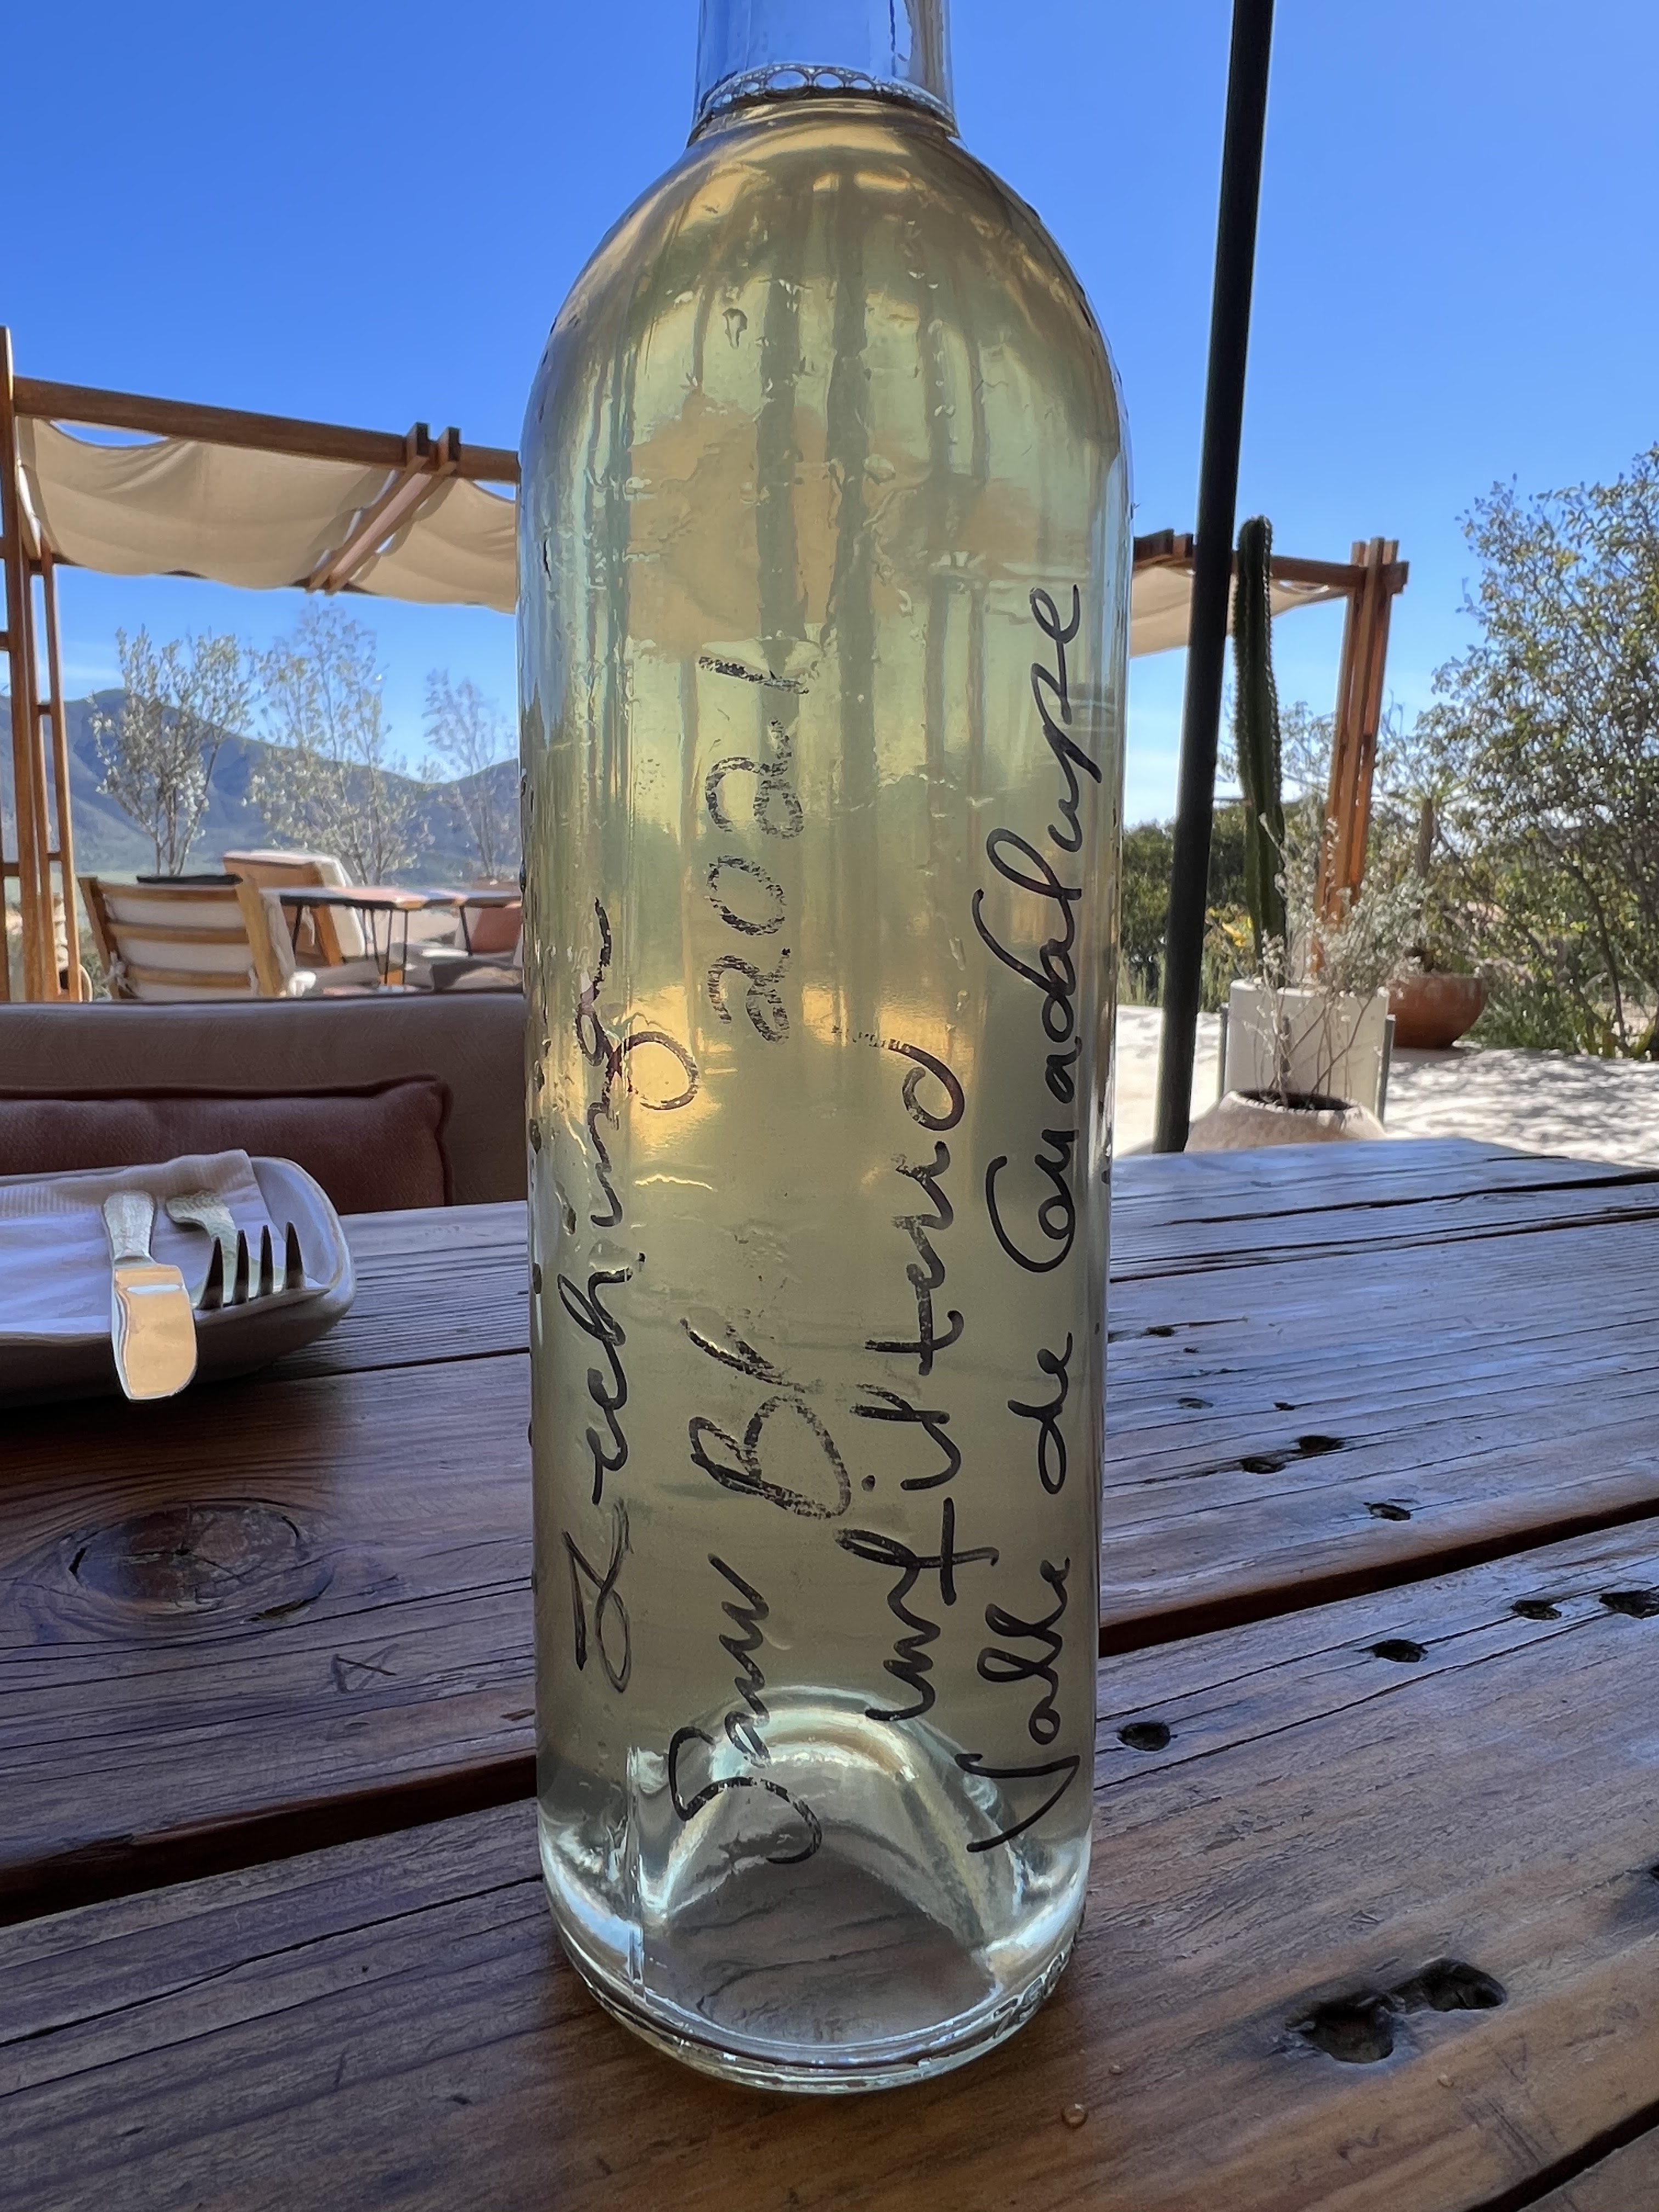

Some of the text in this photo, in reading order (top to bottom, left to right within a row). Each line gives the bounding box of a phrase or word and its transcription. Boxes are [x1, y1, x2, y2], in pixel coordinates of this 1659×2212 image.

[698, 656, 809, 1043] 2021
[954, 584, 1102, 1853] Valle de Guadalupe
